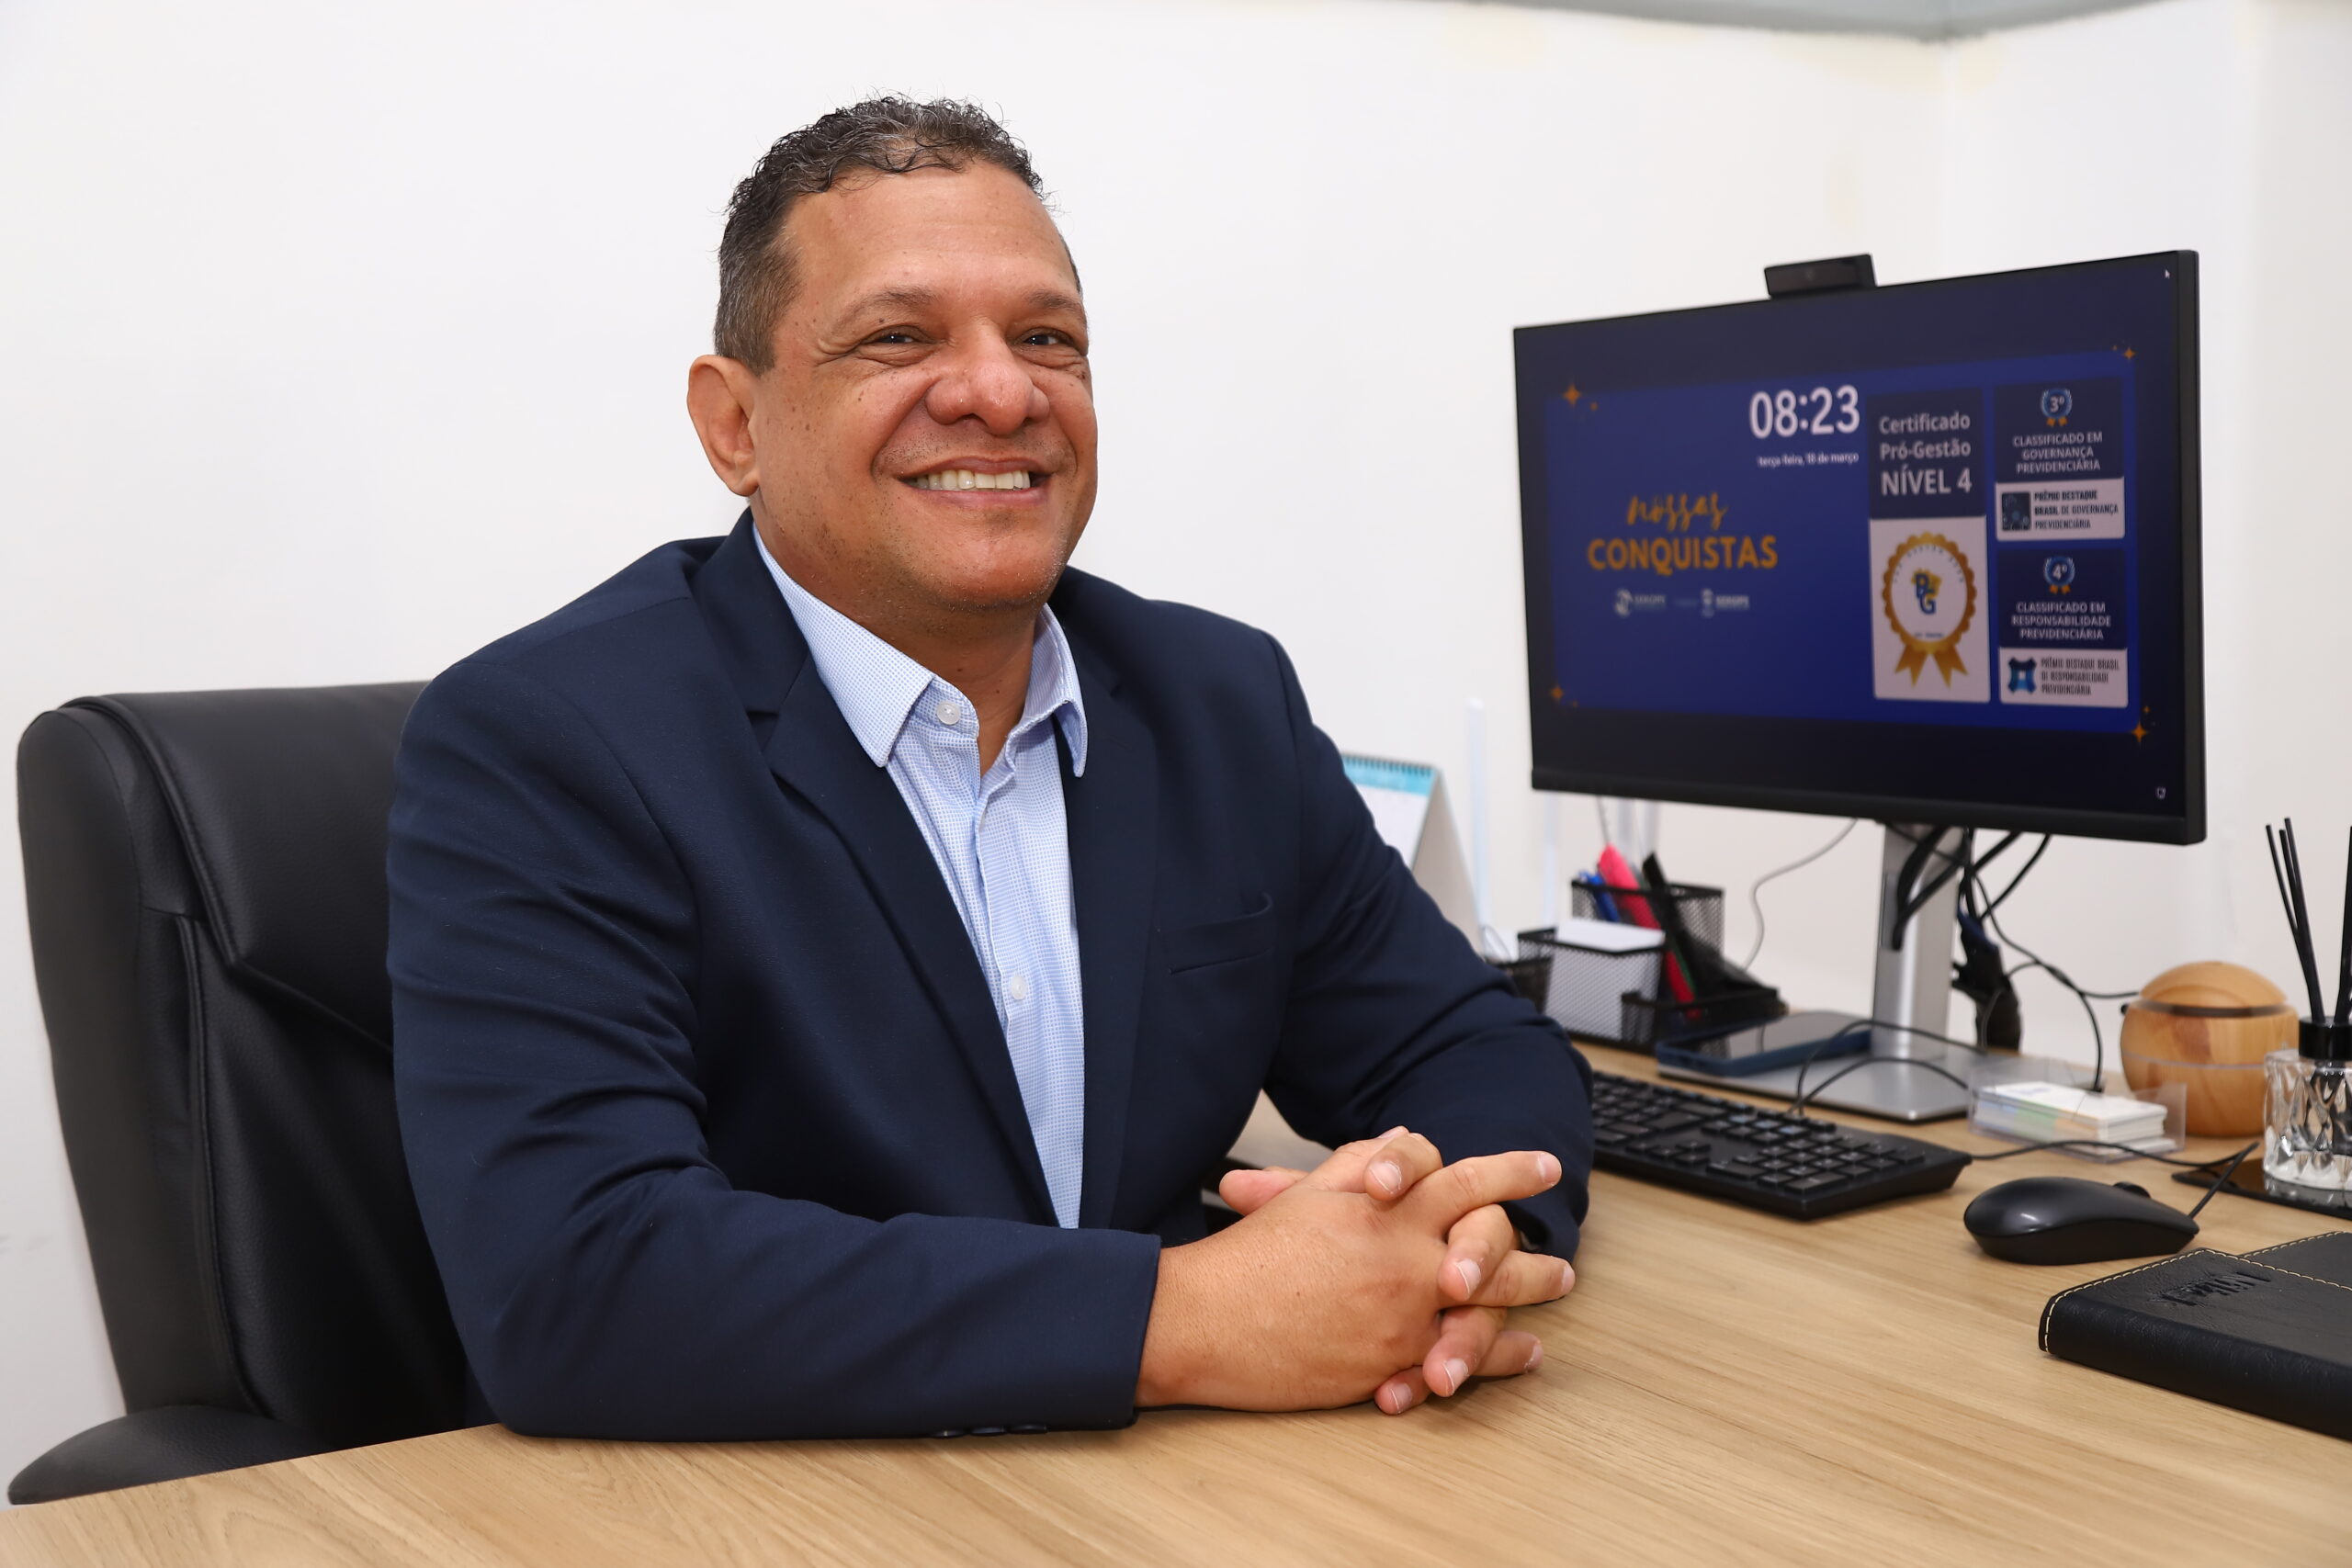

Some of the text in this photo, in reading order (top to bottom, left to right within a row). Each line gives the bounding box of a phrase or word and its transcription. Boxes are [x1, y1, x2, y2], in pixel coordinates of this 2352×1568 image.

[1749, 385, 1860, 438] 08:23
[1879, 412, 1971, 434] Certificado
[2013, 432, 2103, 447] CLASSIFICADO EM
[1880, 439, 1972, 460] Pró-Gestão
[2022, 446, 2094, 461] GOVERNANÇA
[2016, 458, 2101, 474] PREVIDENCIÁRIA
[1882, 465, 1973, 496] NÍVEL 4
[1588, 536, 1779, 576] CONQUISTAS
[2017, 602, 2106, 614] CLASSIFICADO EM
[2012, 615, 2110, 626] RESPONSABILIDADE
[2020, 626, 2104, 639] PREVIDENCIÁRIA
